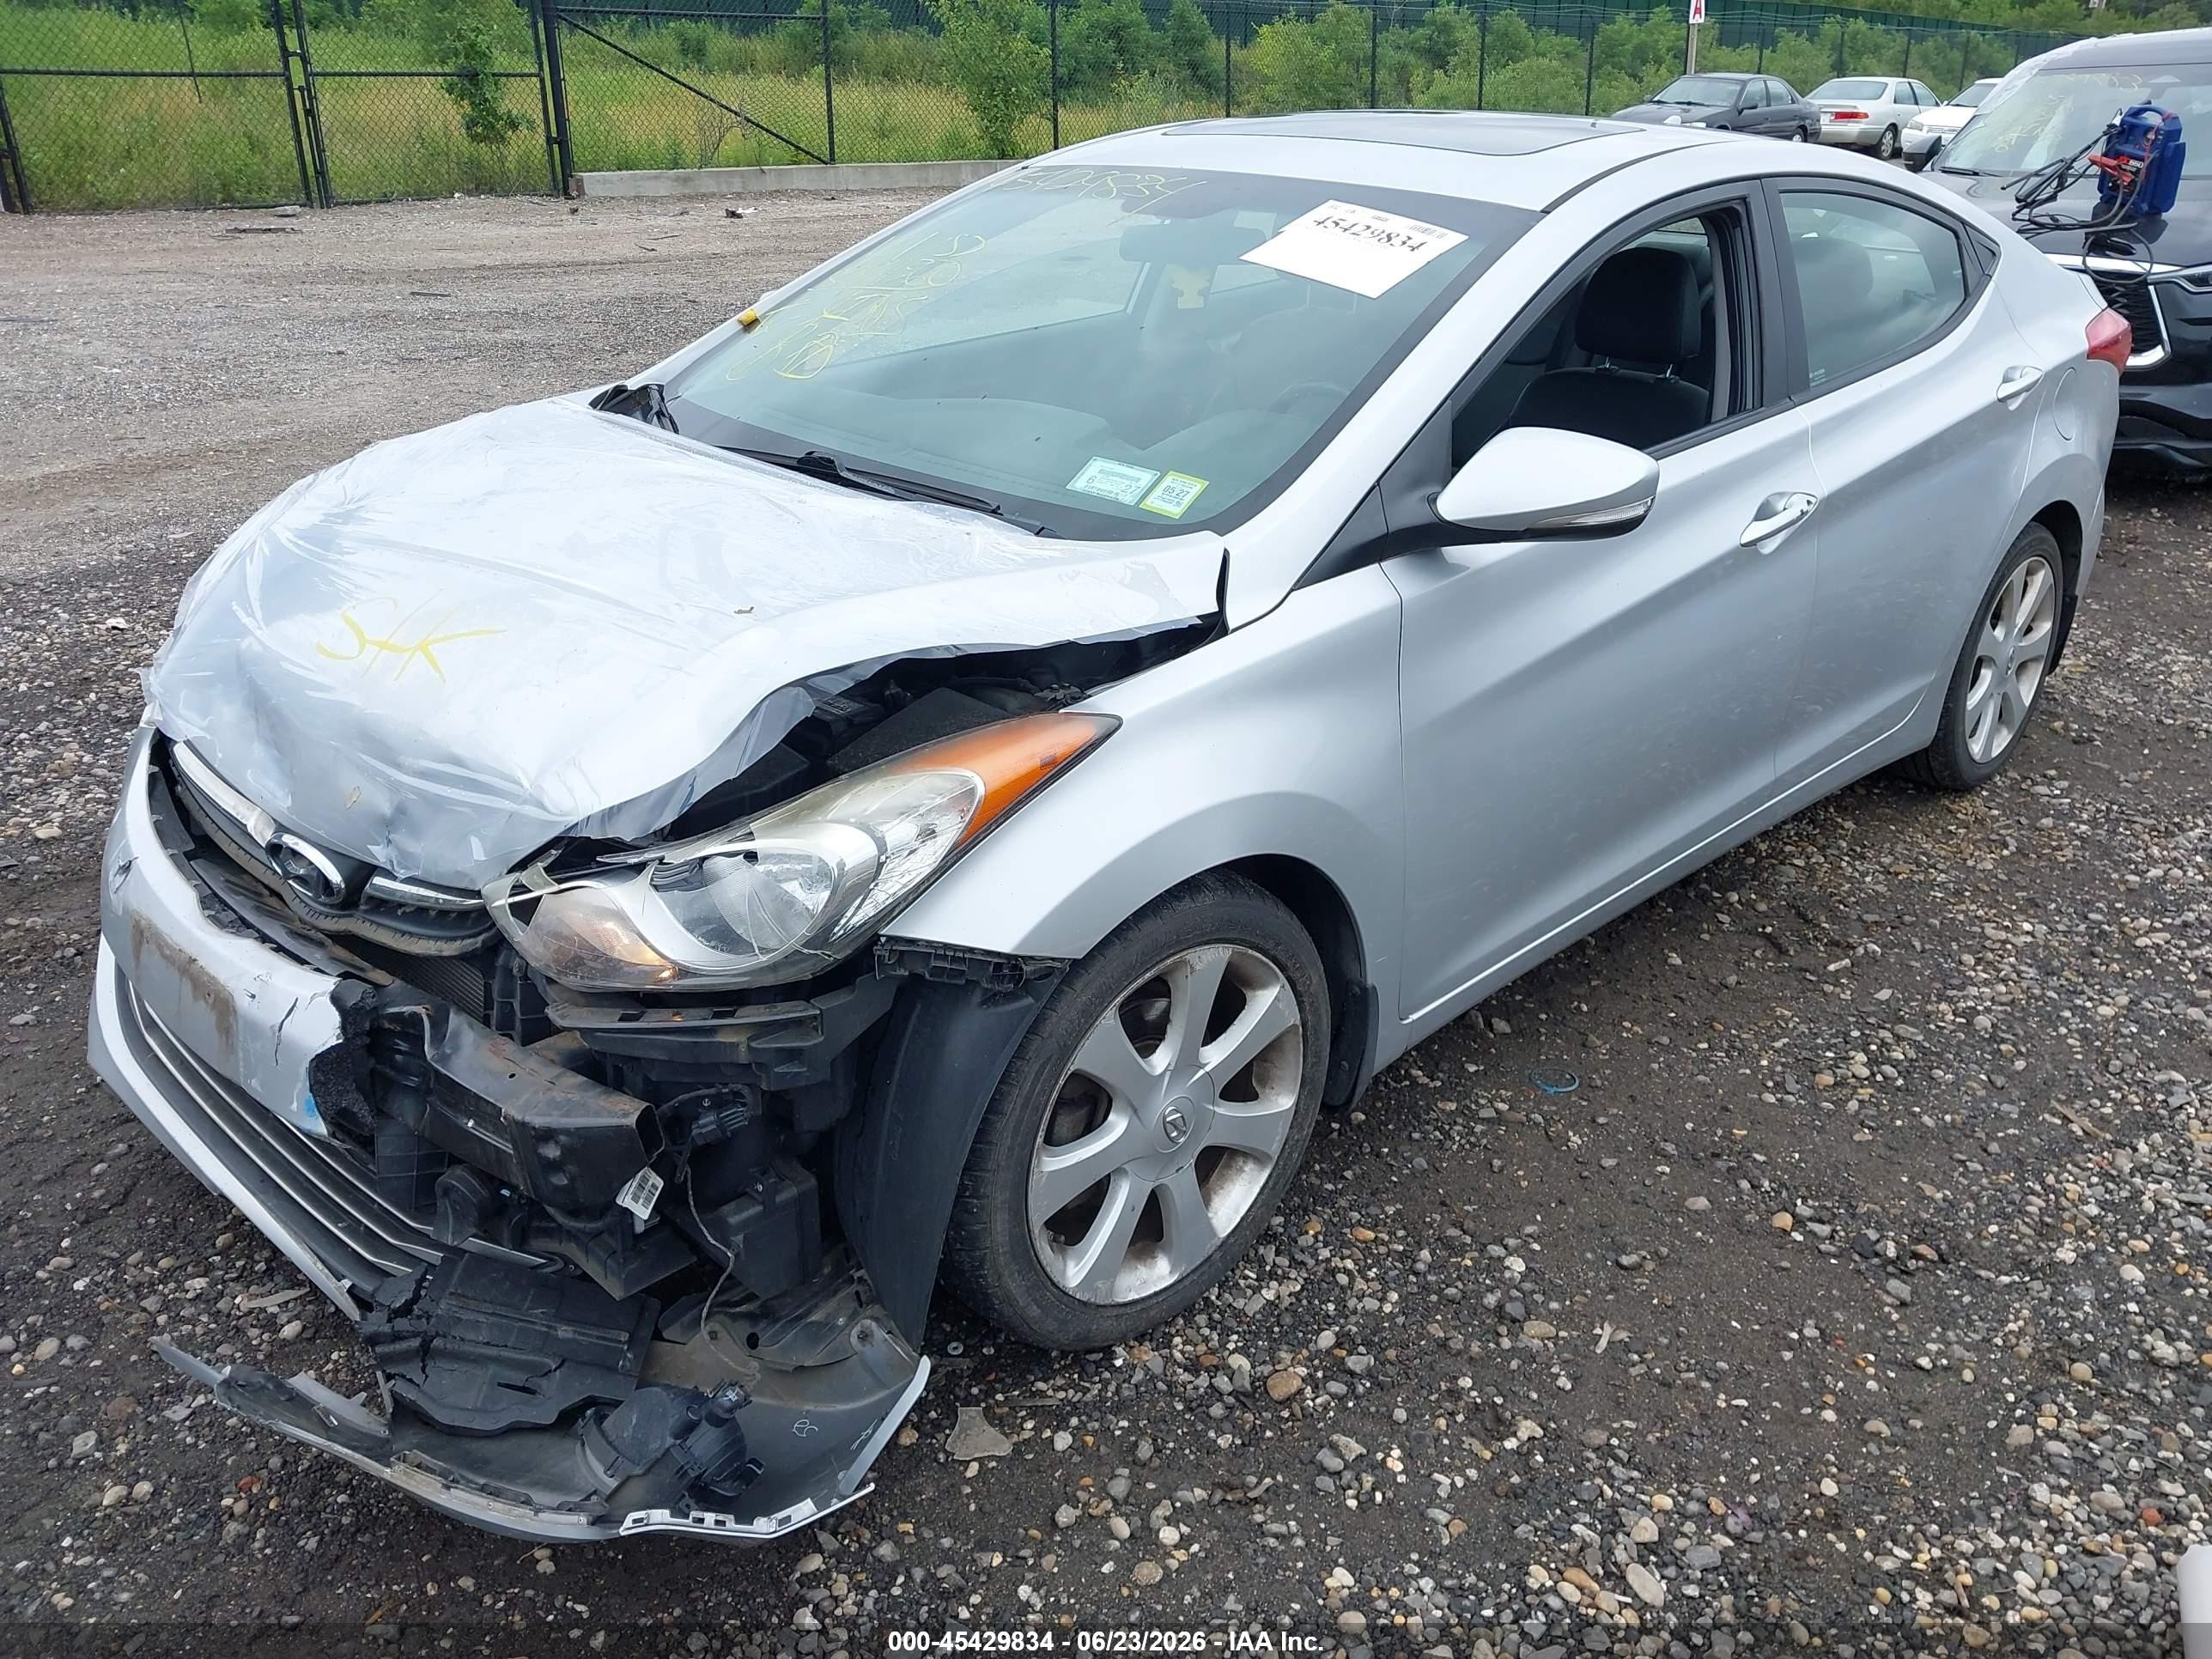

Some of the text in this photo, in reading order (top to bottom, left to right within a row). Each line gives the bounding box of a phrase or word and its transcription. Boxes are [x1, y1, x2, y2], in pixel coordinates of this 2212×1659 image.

[1692, 0, 1702, 20] A
[1313, 216, 1428, 252] 45429834
[1121, 483, 1141, 495] 27
[1162, 484, 1177, 495] 05
[1176, 489, 1190, 498] 27
